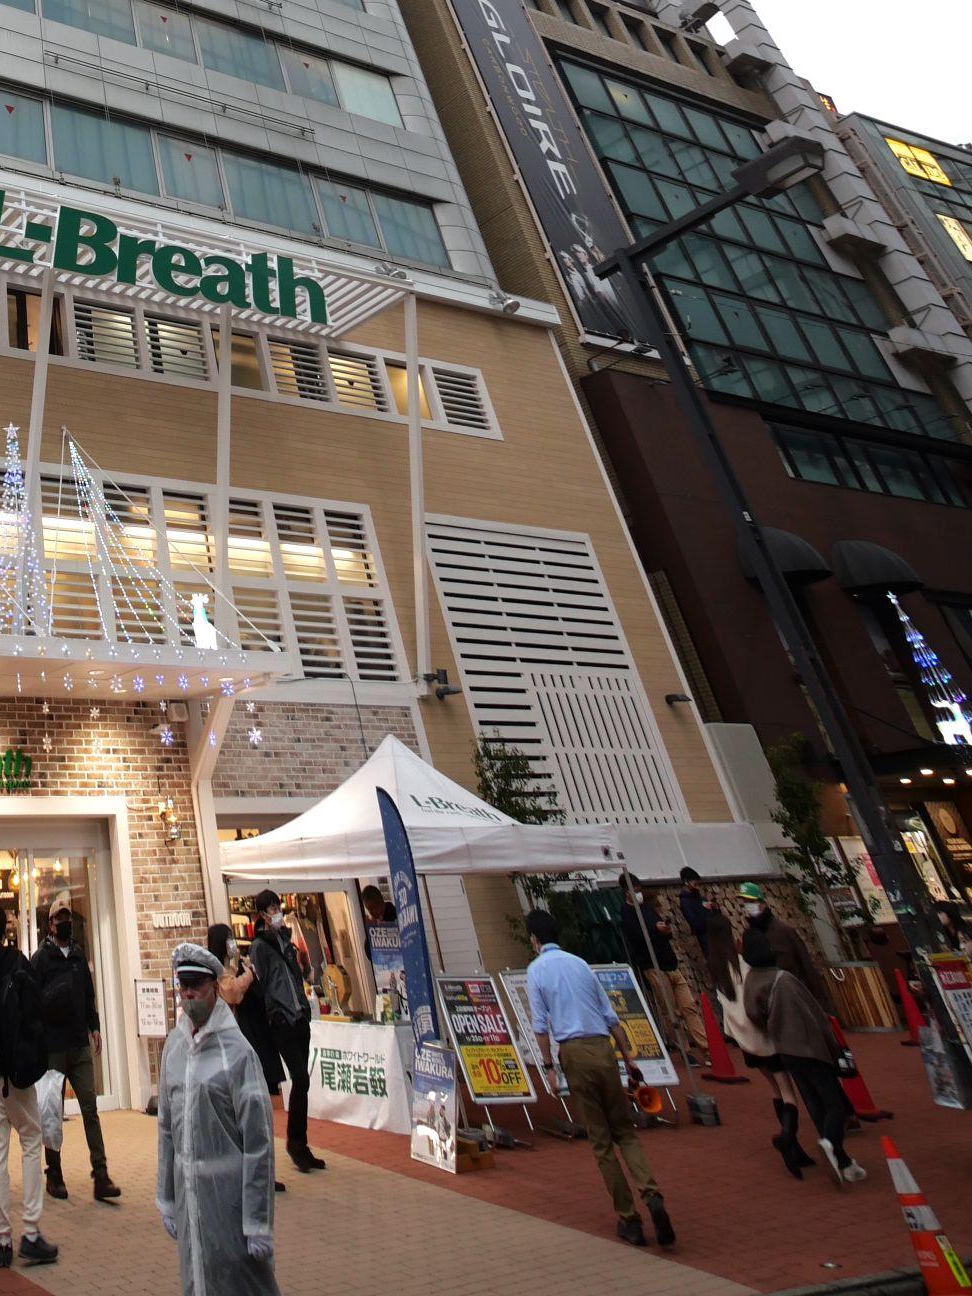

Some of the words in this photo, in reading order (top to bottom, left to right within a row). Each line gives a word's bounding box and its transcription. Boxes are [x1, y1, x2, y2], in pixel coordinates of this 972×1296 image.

[410, 794, 502, 822] L-Breath
[152, 911, 192, 928] OUTDOOR
[369, 926, 387, 938] OZE
[451, 1013, 481, 1034] OPEN
[478, 1013, 508, 1034] SALE
[320, 1060, 389, 1099] 尾瀬岩鞍
[415, 1058, 454, 1081] IWAKURA
[501, 1072, 522, 1085] OFF
